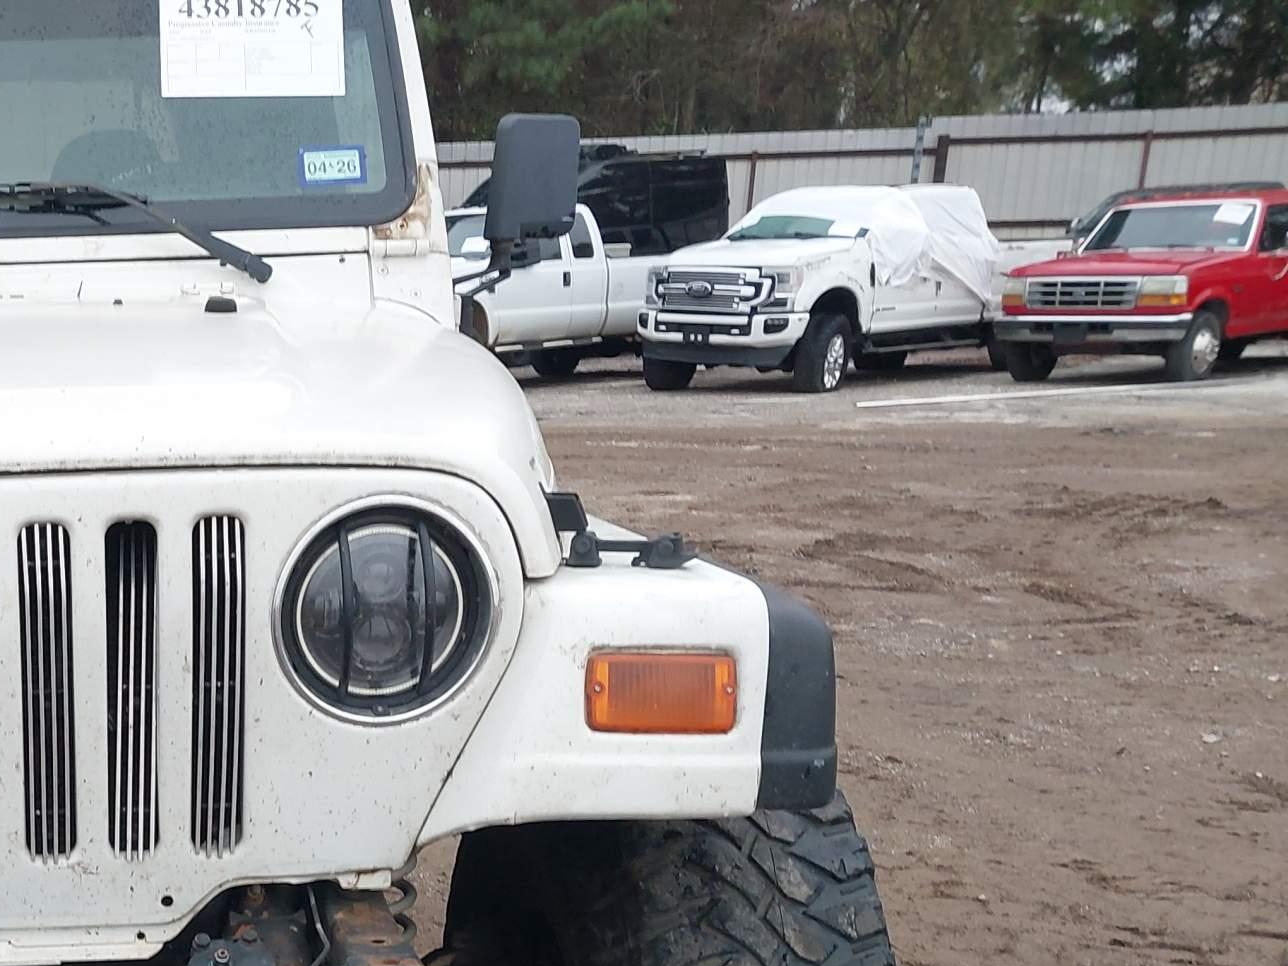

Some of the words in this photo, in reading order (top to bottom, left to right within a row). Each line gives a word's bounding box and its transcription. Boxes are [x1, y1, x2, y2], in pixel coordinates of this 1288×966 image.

[178, 0, 319, 18] 43818785
[168, 19, 209, 28] Progressive
[245, 18, 280, 27] Insurance
[308, 160, 327, 175] 04
[336, 159, 357, 173] 26
